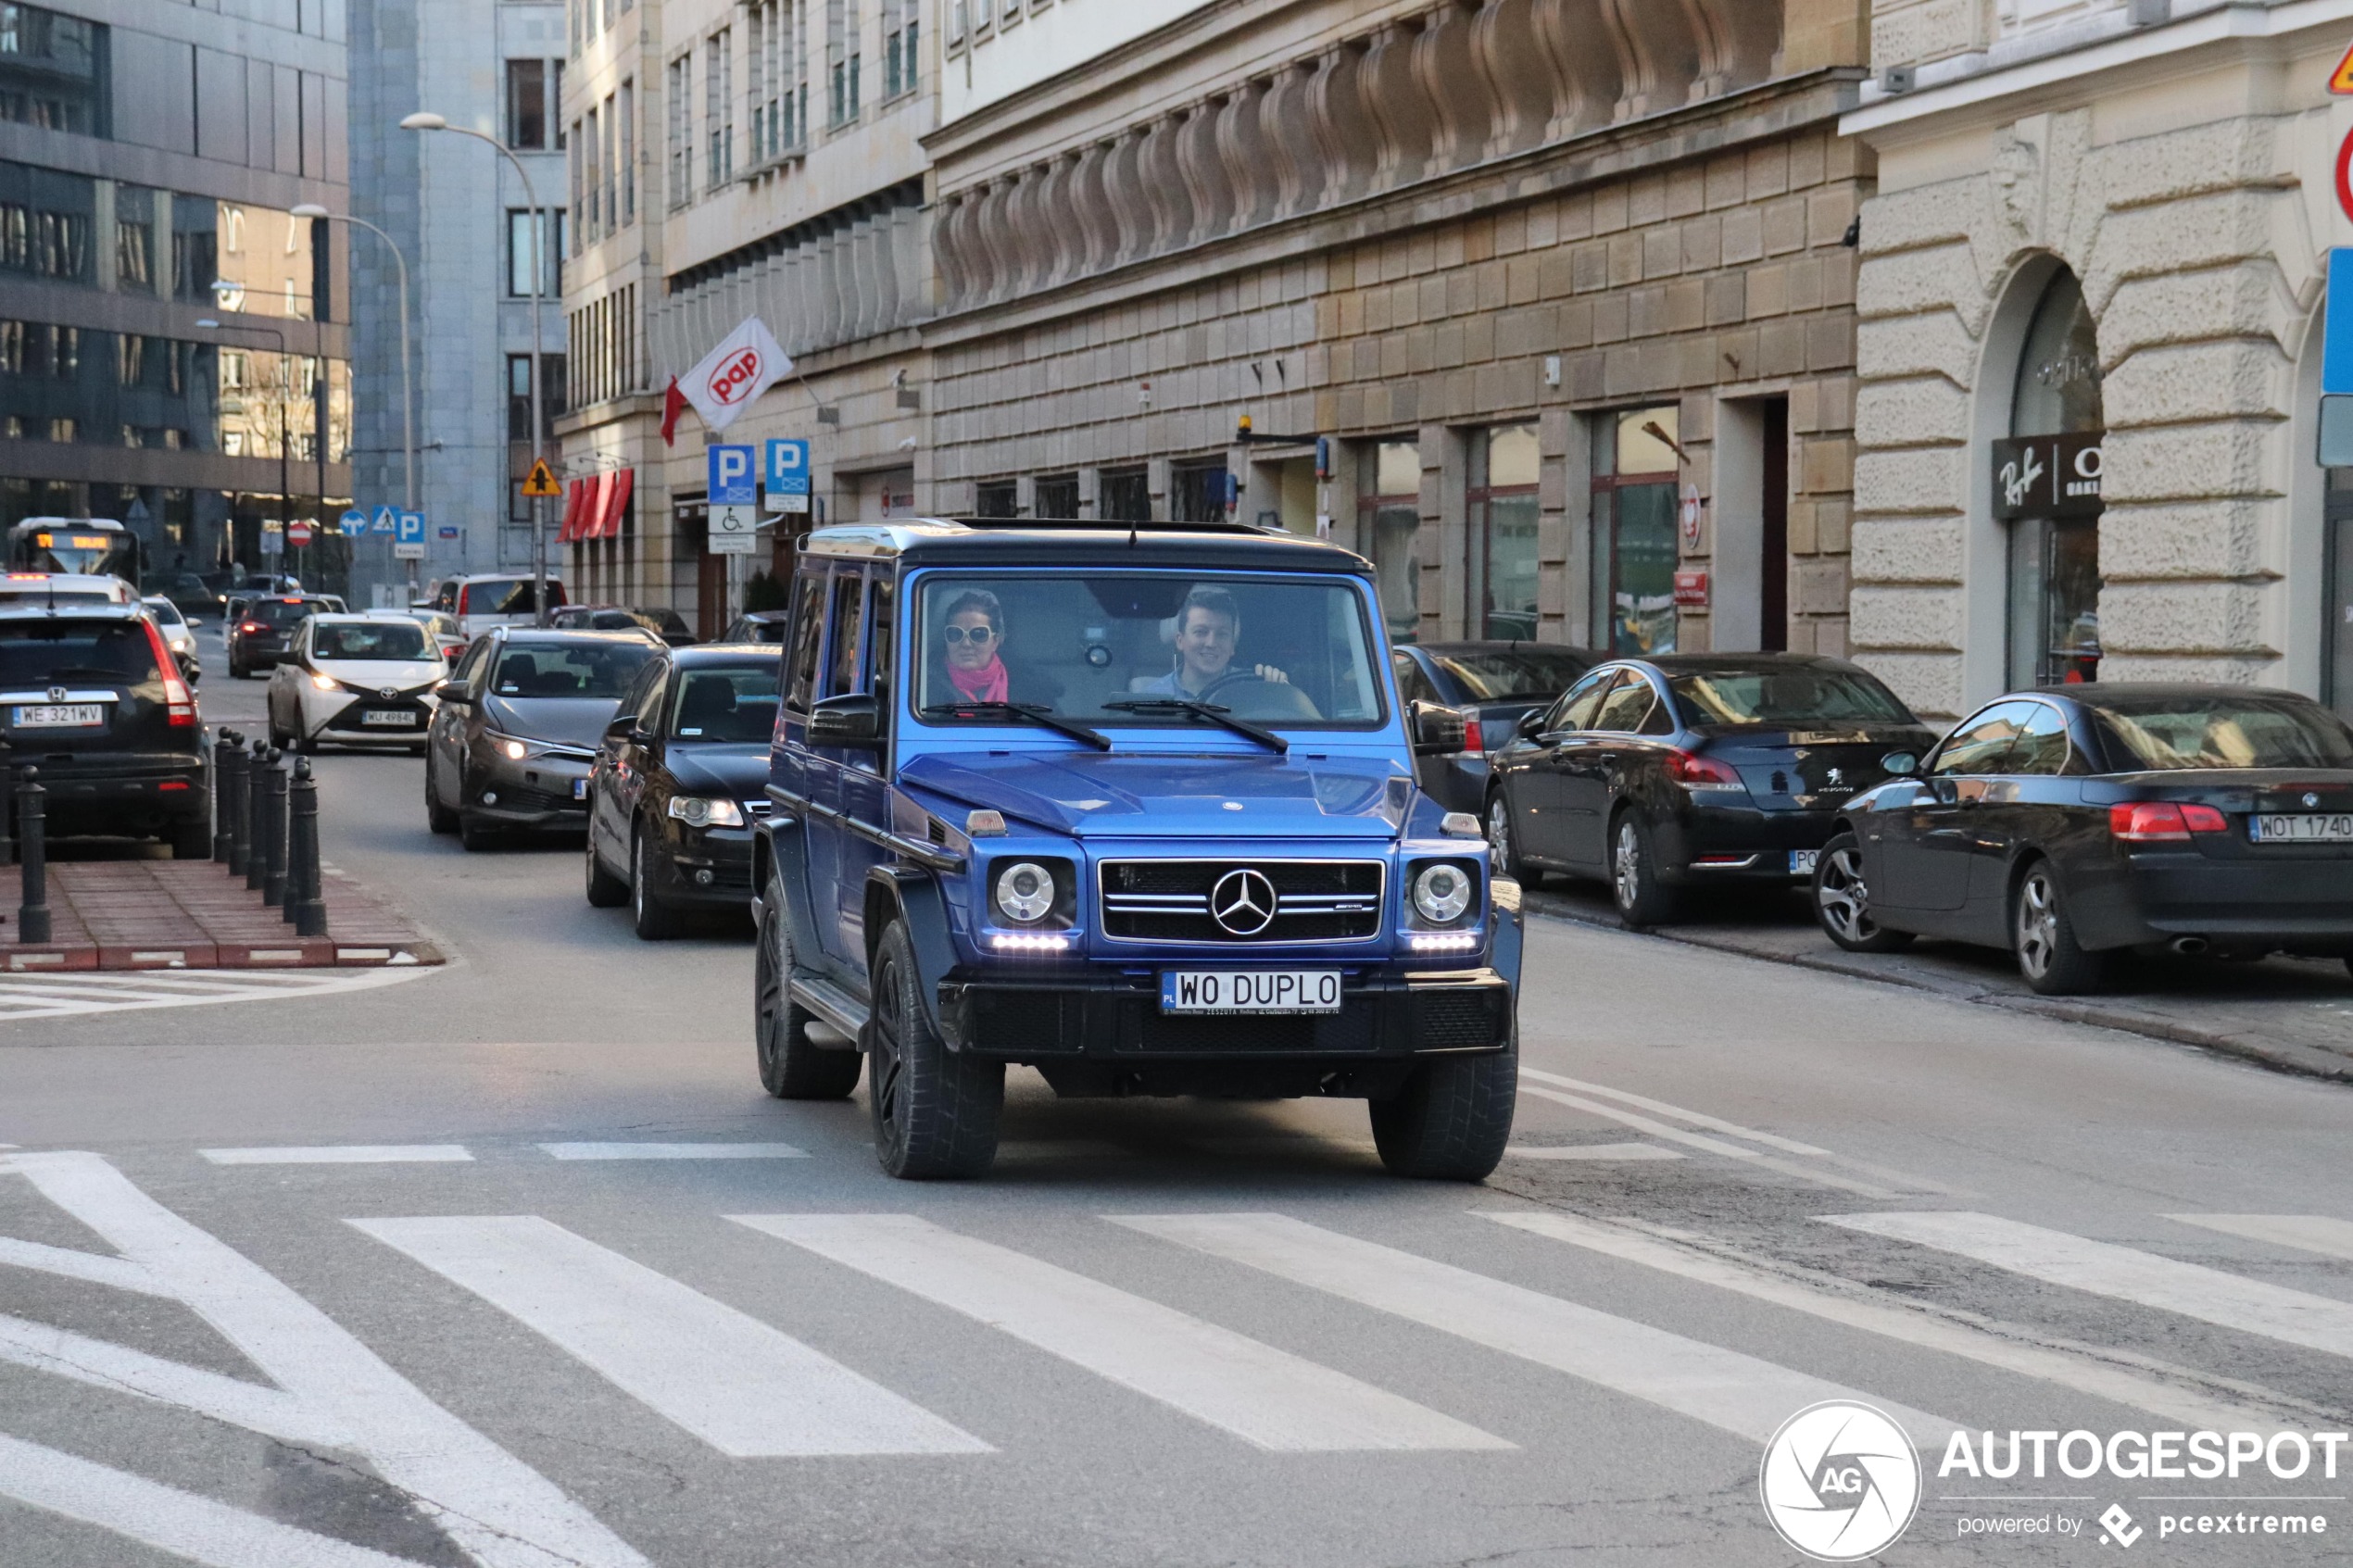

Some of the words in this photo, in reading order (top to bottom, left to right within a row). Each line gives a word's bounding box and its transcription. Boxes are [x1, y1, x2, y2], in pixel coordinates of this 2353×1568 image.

[711, 352, 757, 403] pap
[718, 449, 747, 488] P
[774, 443, 801, 478] P
[400, 515, 420, 541] P
[24, 707, 44, 722] WE
[50, 706, 98, 721] 321WV
[369, 711, 383, 721] WU
[385, 712, 414, 722] 4984C
[2260, 816, 2297, 836] WOT
[2306, 816, 2351, 836] 1740
[1164, 994, 1175, 1003] PL
[1180, 974, 1219, 1005] WO
[1234, 974, 1337, 1005] DUPLO
